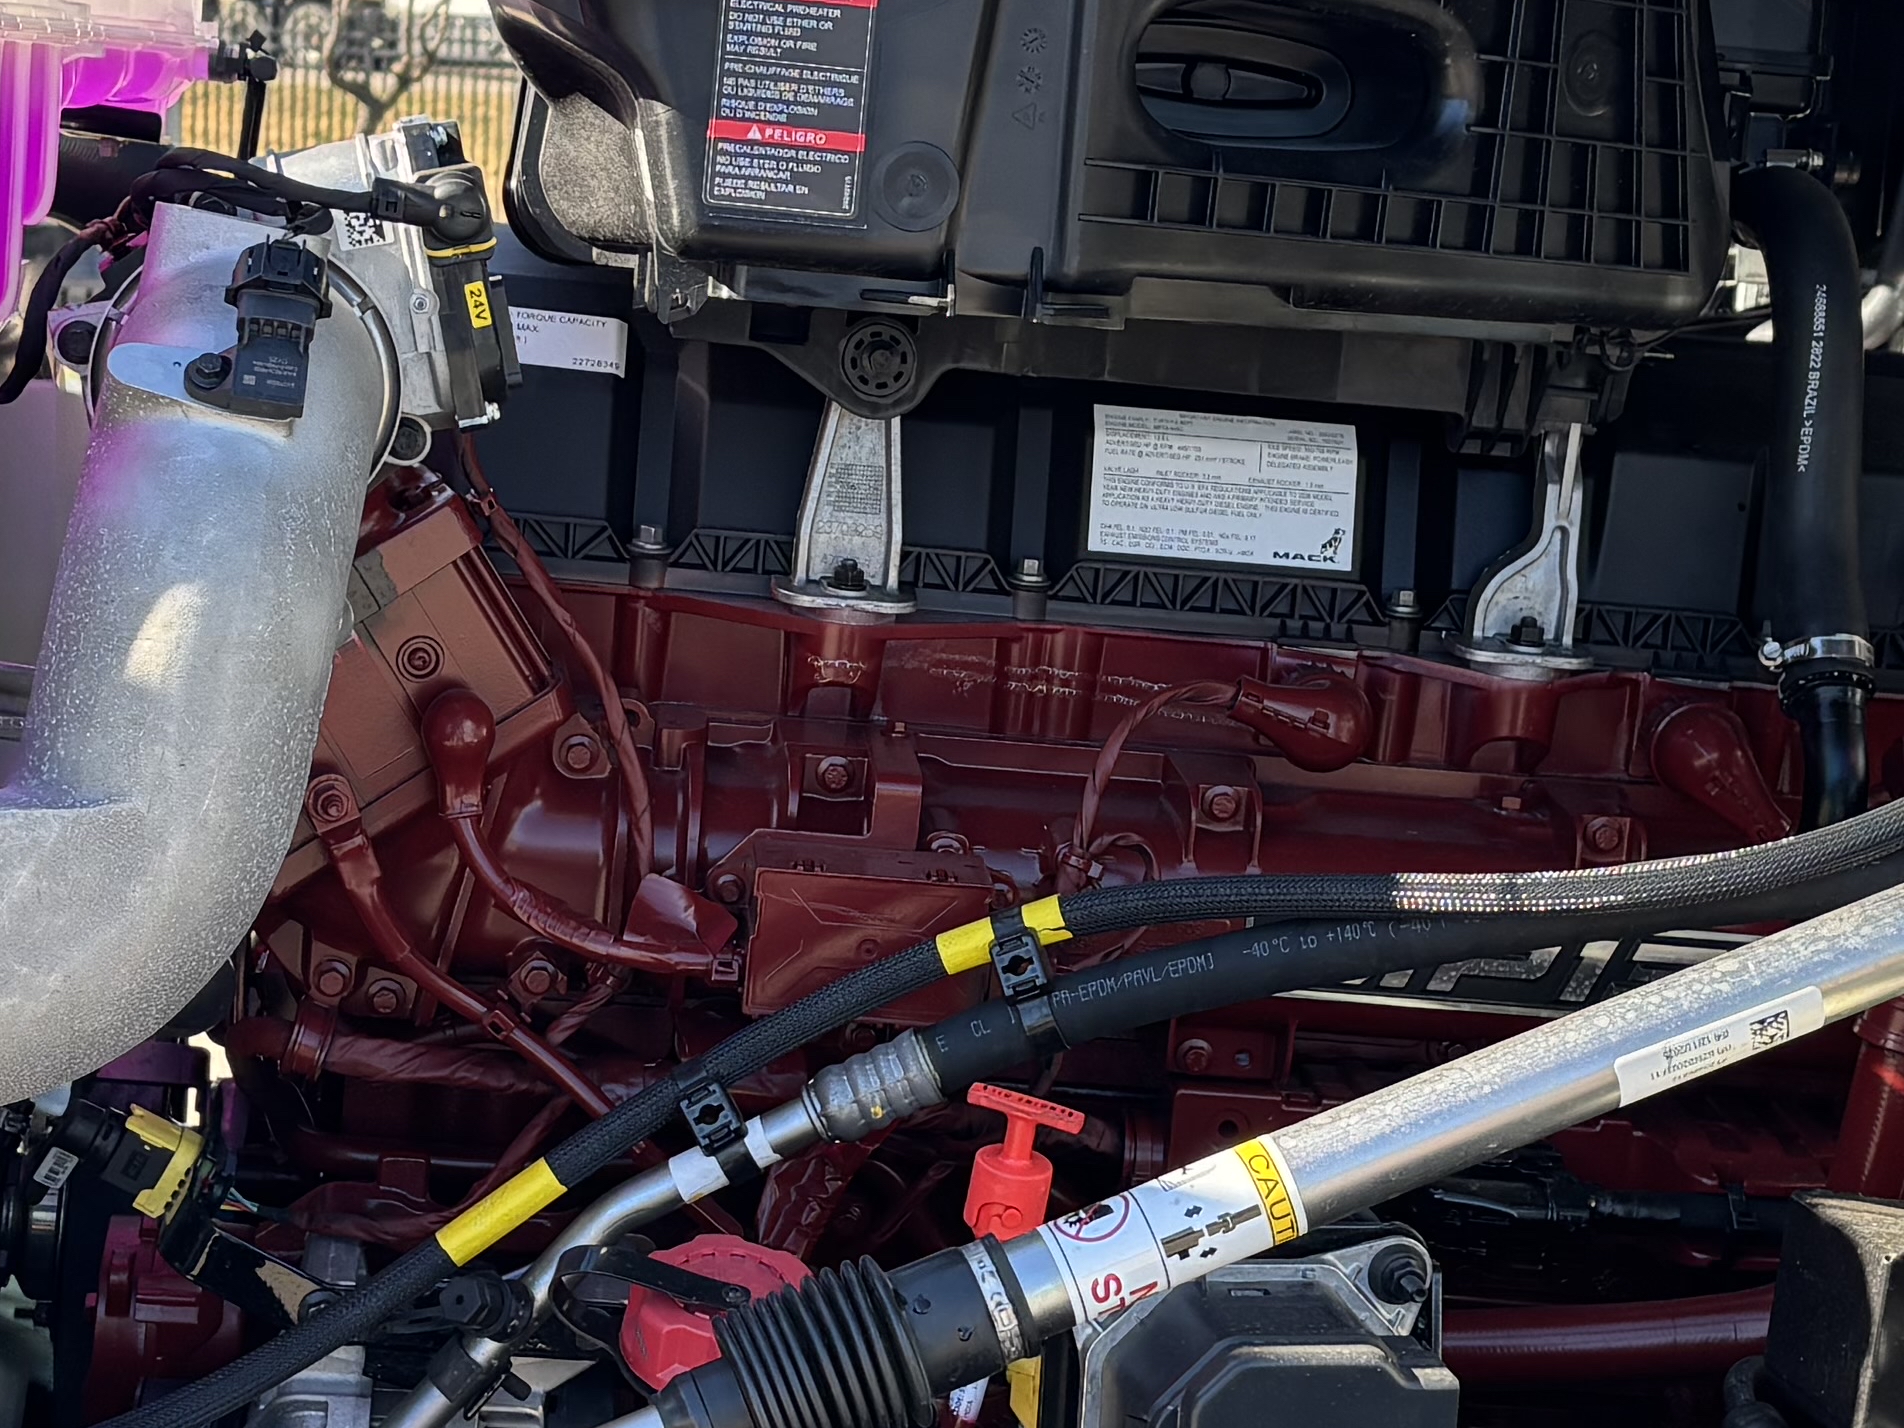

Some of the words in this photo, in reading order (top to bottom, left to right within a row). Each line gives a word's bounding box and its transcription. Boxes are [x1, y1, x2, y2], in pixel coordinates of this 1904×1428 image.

[786, 3, 841, 18] PREHEATER
[728, 11, 742, 21] DO
[743, 12, 762, 23] NOT
[765, 15, 785, 25] USE
[785, 17, 817, 28] ETHER
[818, 20, 833, 30] OR
[764, 127, 827, 145] PELIGRO
[468, 287, 489, 322] 24V
[516, 311, 556, 323] TORQUE
[558, 315, 607, 328] CAPACITY
[1272, 551, 1338, 564] MACK
